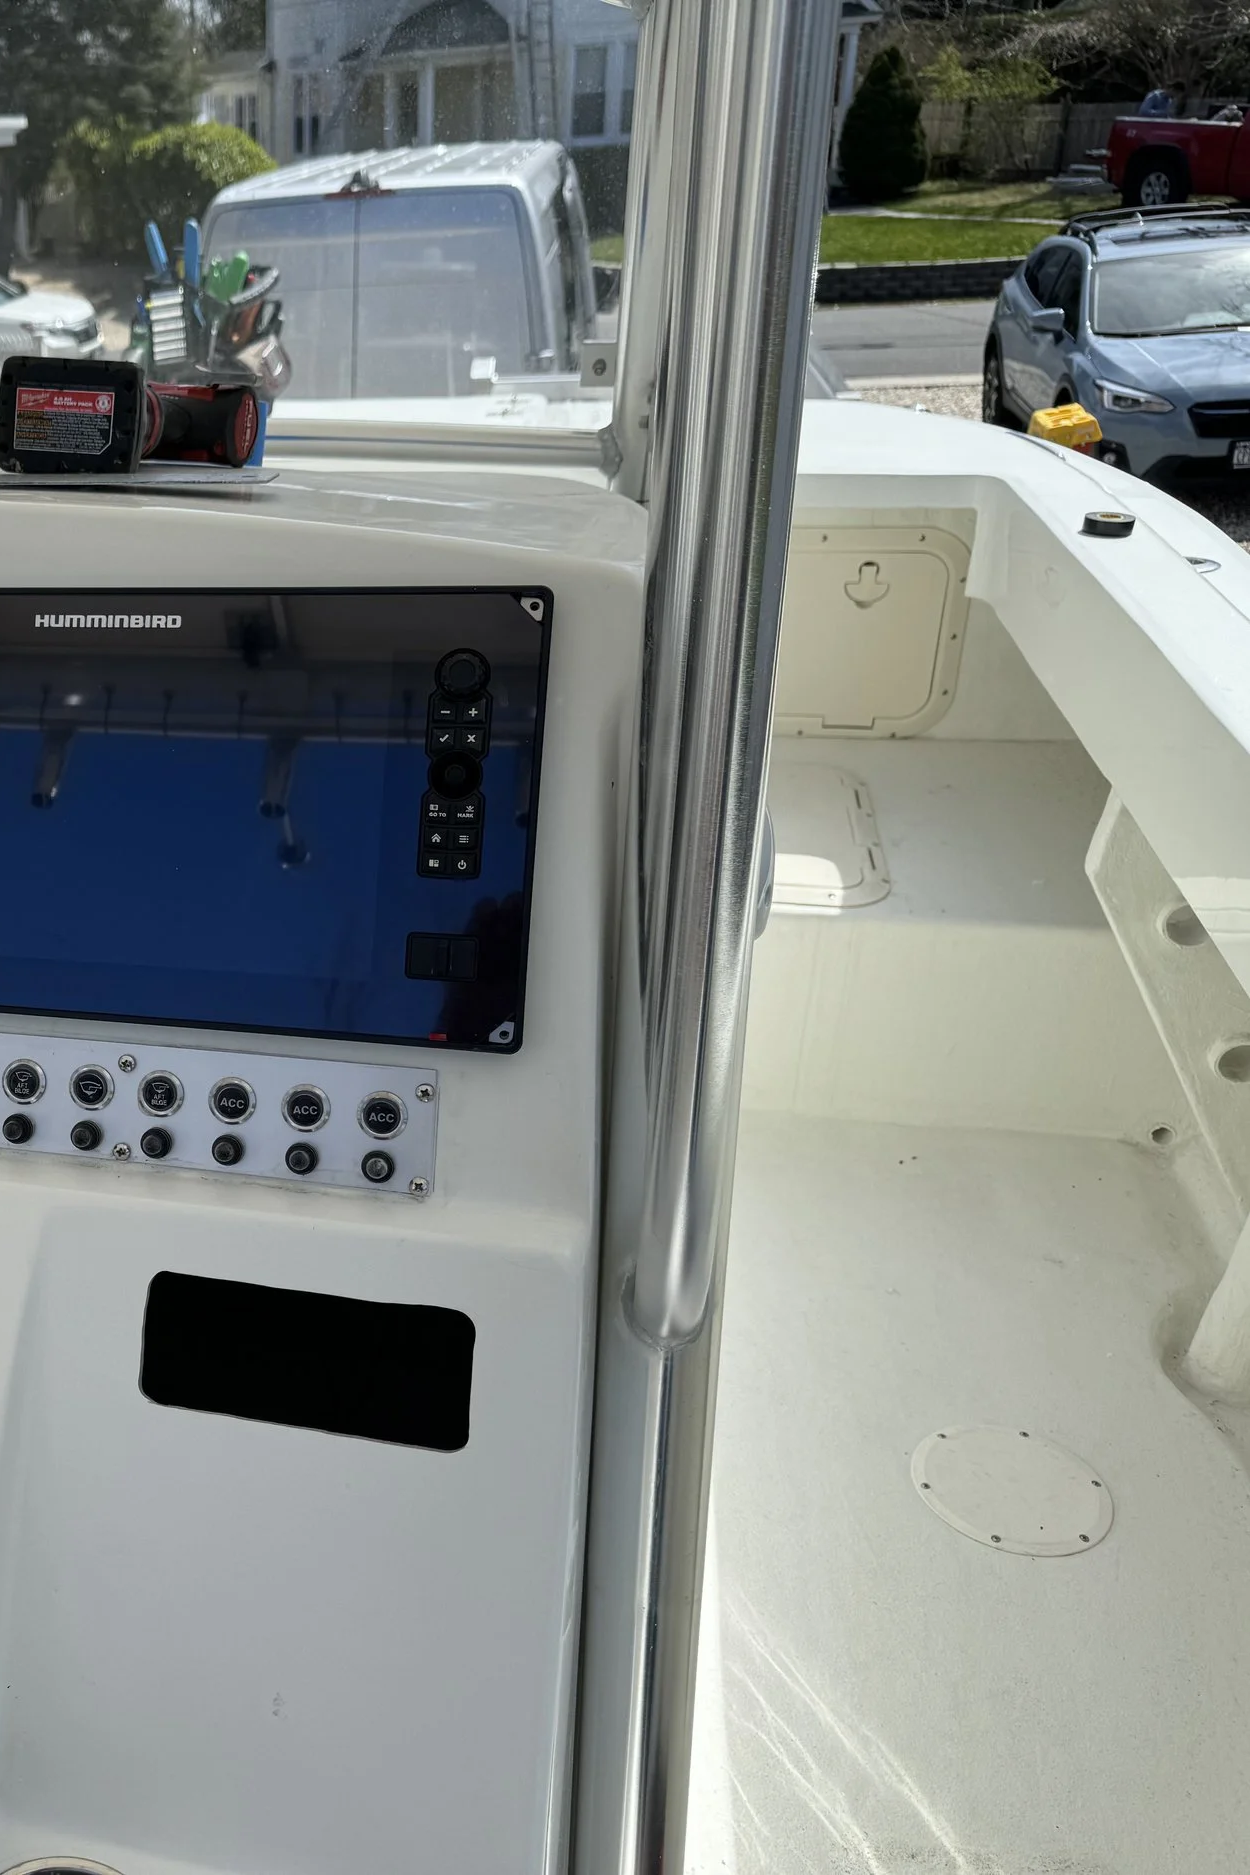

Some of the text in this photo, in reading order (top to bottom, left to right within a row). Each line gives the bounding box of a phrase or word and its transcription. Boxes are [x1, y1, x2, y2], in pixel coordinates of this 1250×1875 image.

[34, 614, 182, 629] HUMMINBIRD
[219, 1097, 245, 1109] ACC
[292, 1104, 318, 1116] ACC
[368, 1112, 395, 1123] ACC
